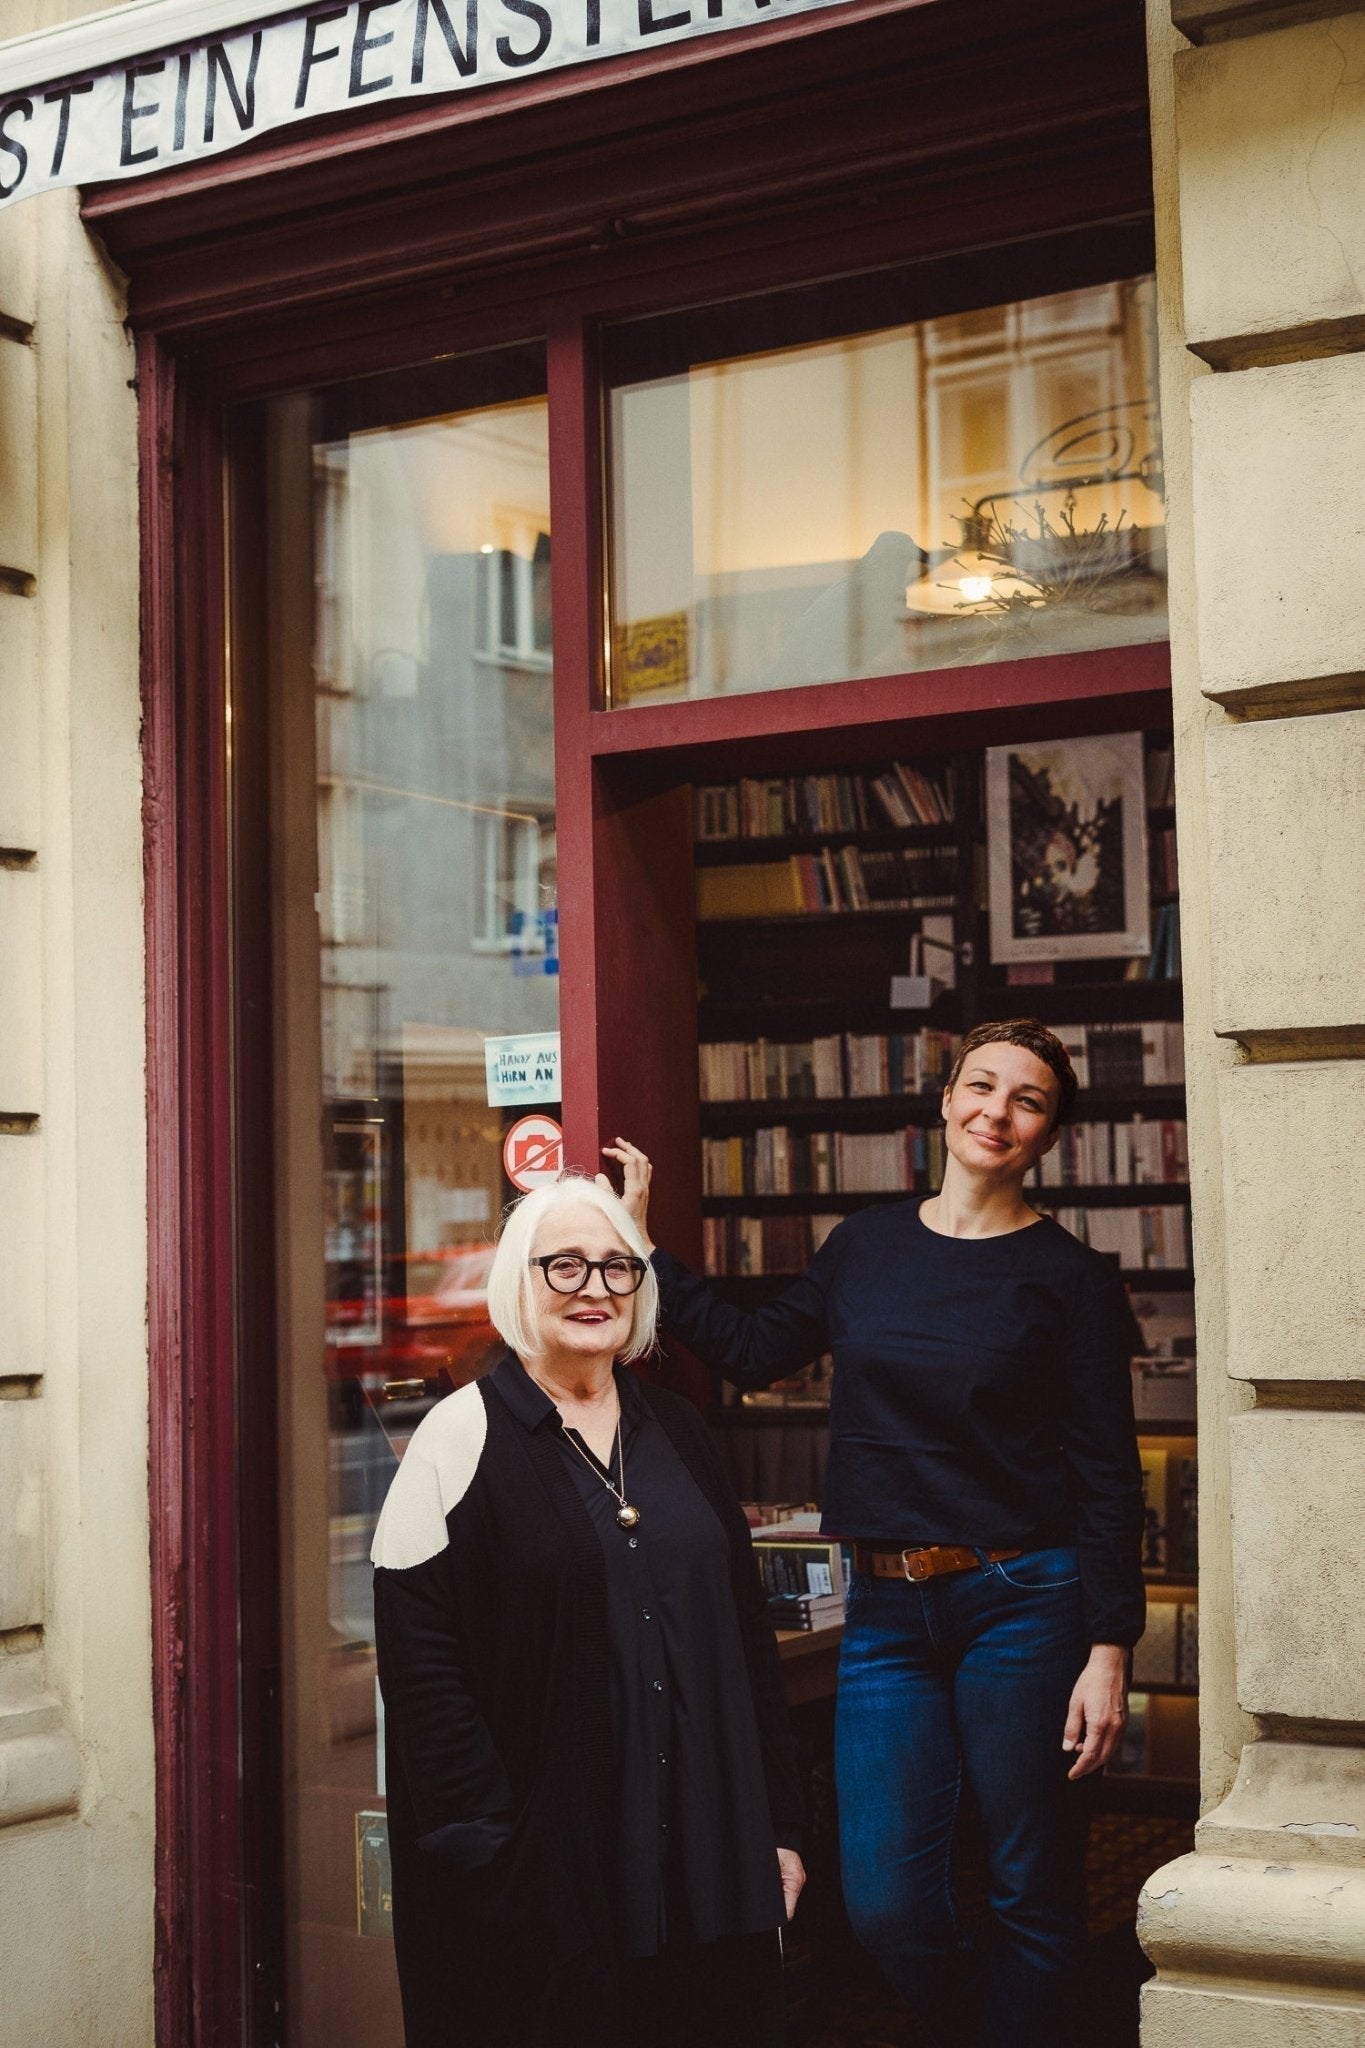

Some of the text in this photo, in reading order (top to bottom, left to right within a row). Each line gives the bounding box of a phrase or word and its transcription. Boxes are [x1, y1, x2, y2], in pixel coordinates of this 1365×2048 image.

[119, 30, 262, 167] EIN
[294, 0, 770, 109] FENS
[500, 1051, 558, 1066] HANDY AUS
[535, 1068, 553, 1081] AN
